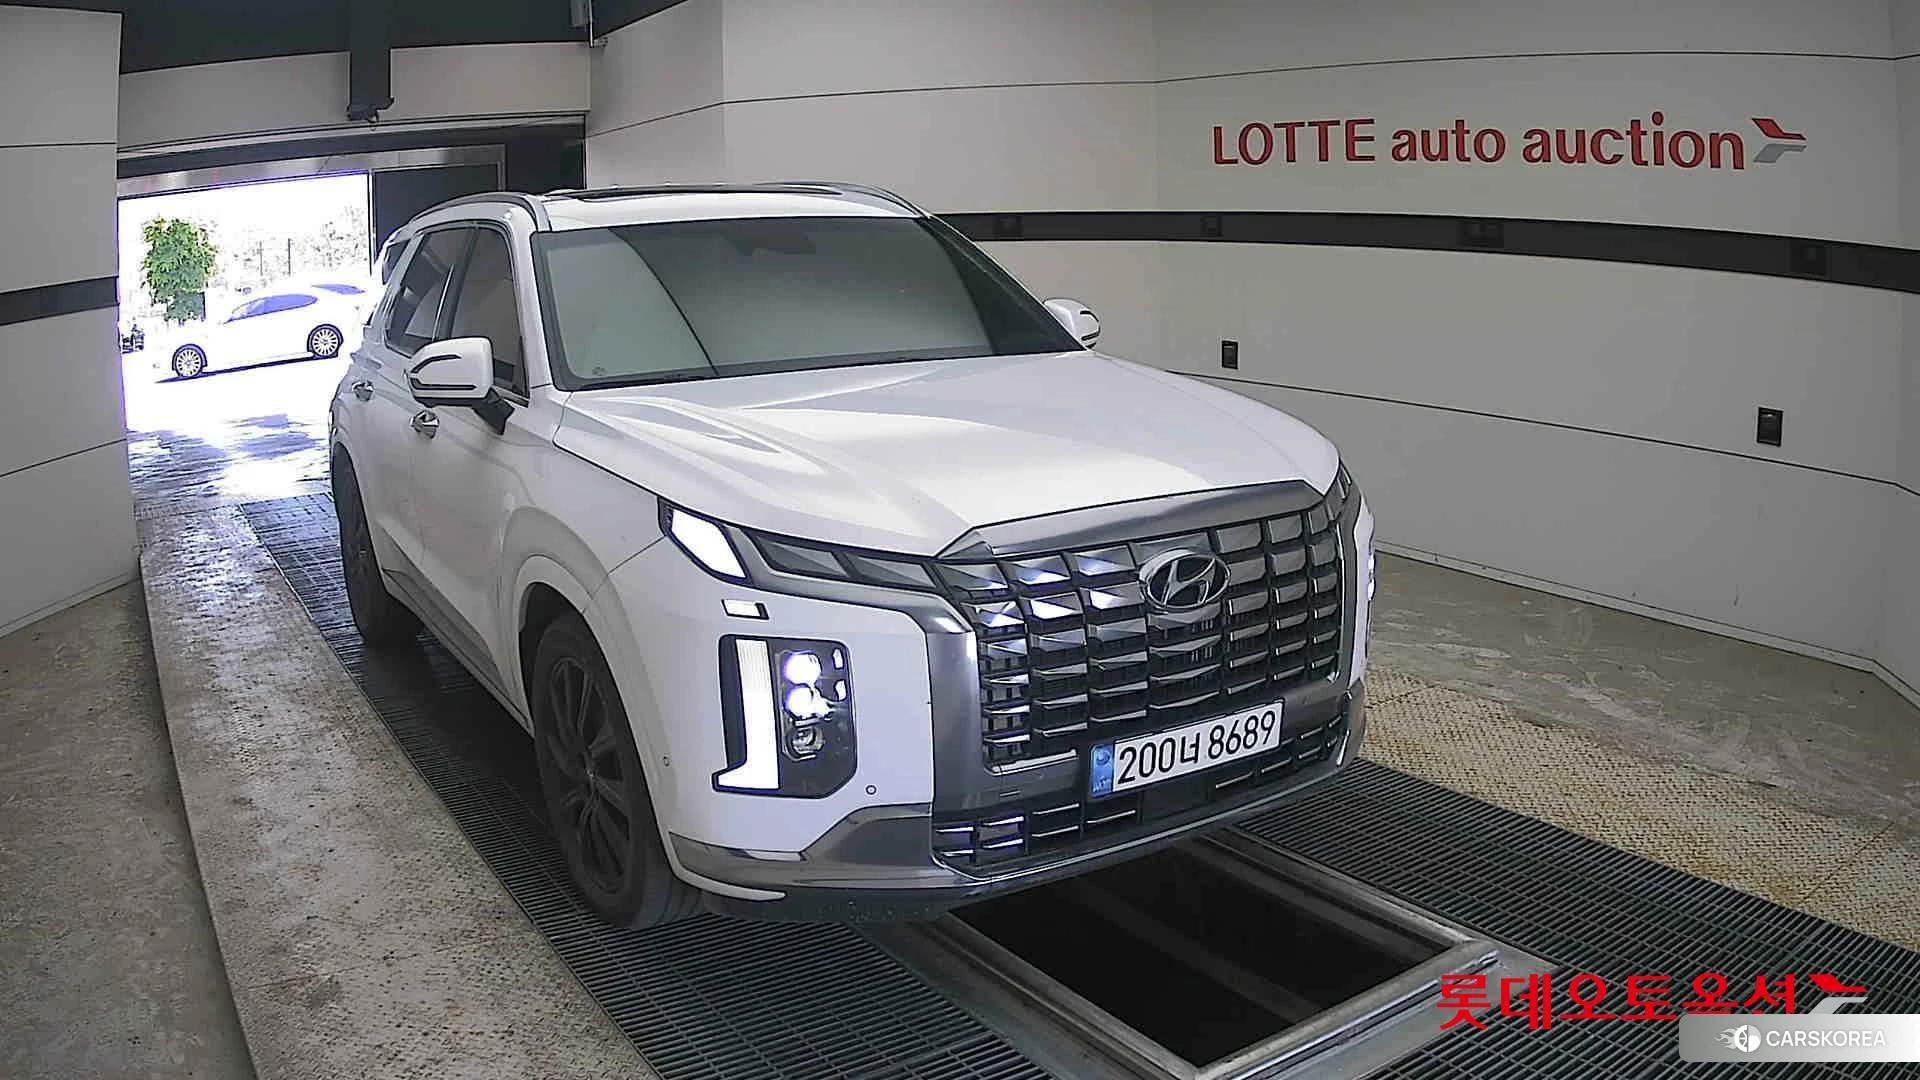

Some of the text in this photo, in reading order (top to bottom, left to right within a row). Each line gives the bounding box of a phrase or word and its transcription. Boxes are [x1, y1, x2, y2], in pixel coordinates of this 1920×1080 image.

[1213, 111, 1745, 169] LOTTE auto auction
[1117, 710, 1276, 785] 200너 8689
